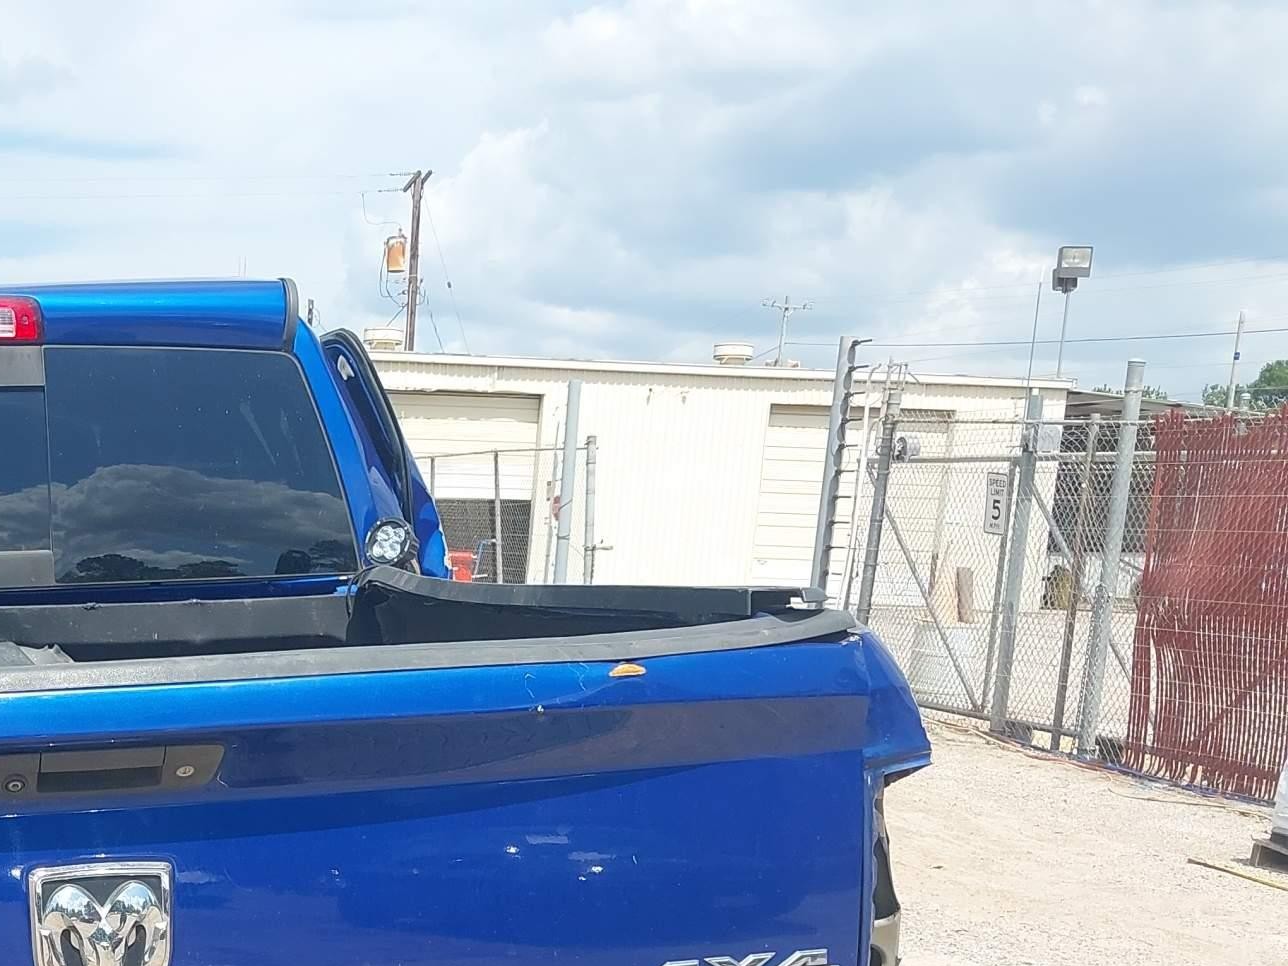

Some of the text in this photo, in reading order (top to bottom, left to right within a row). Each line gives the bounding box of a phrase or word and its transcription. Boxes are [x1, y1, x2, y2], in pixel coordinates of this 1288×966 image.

[989, 478, 1007, 488] SPEED
[990, 488, 1005, 496] LIMIT
[991, 499, 1001, 520] 5
